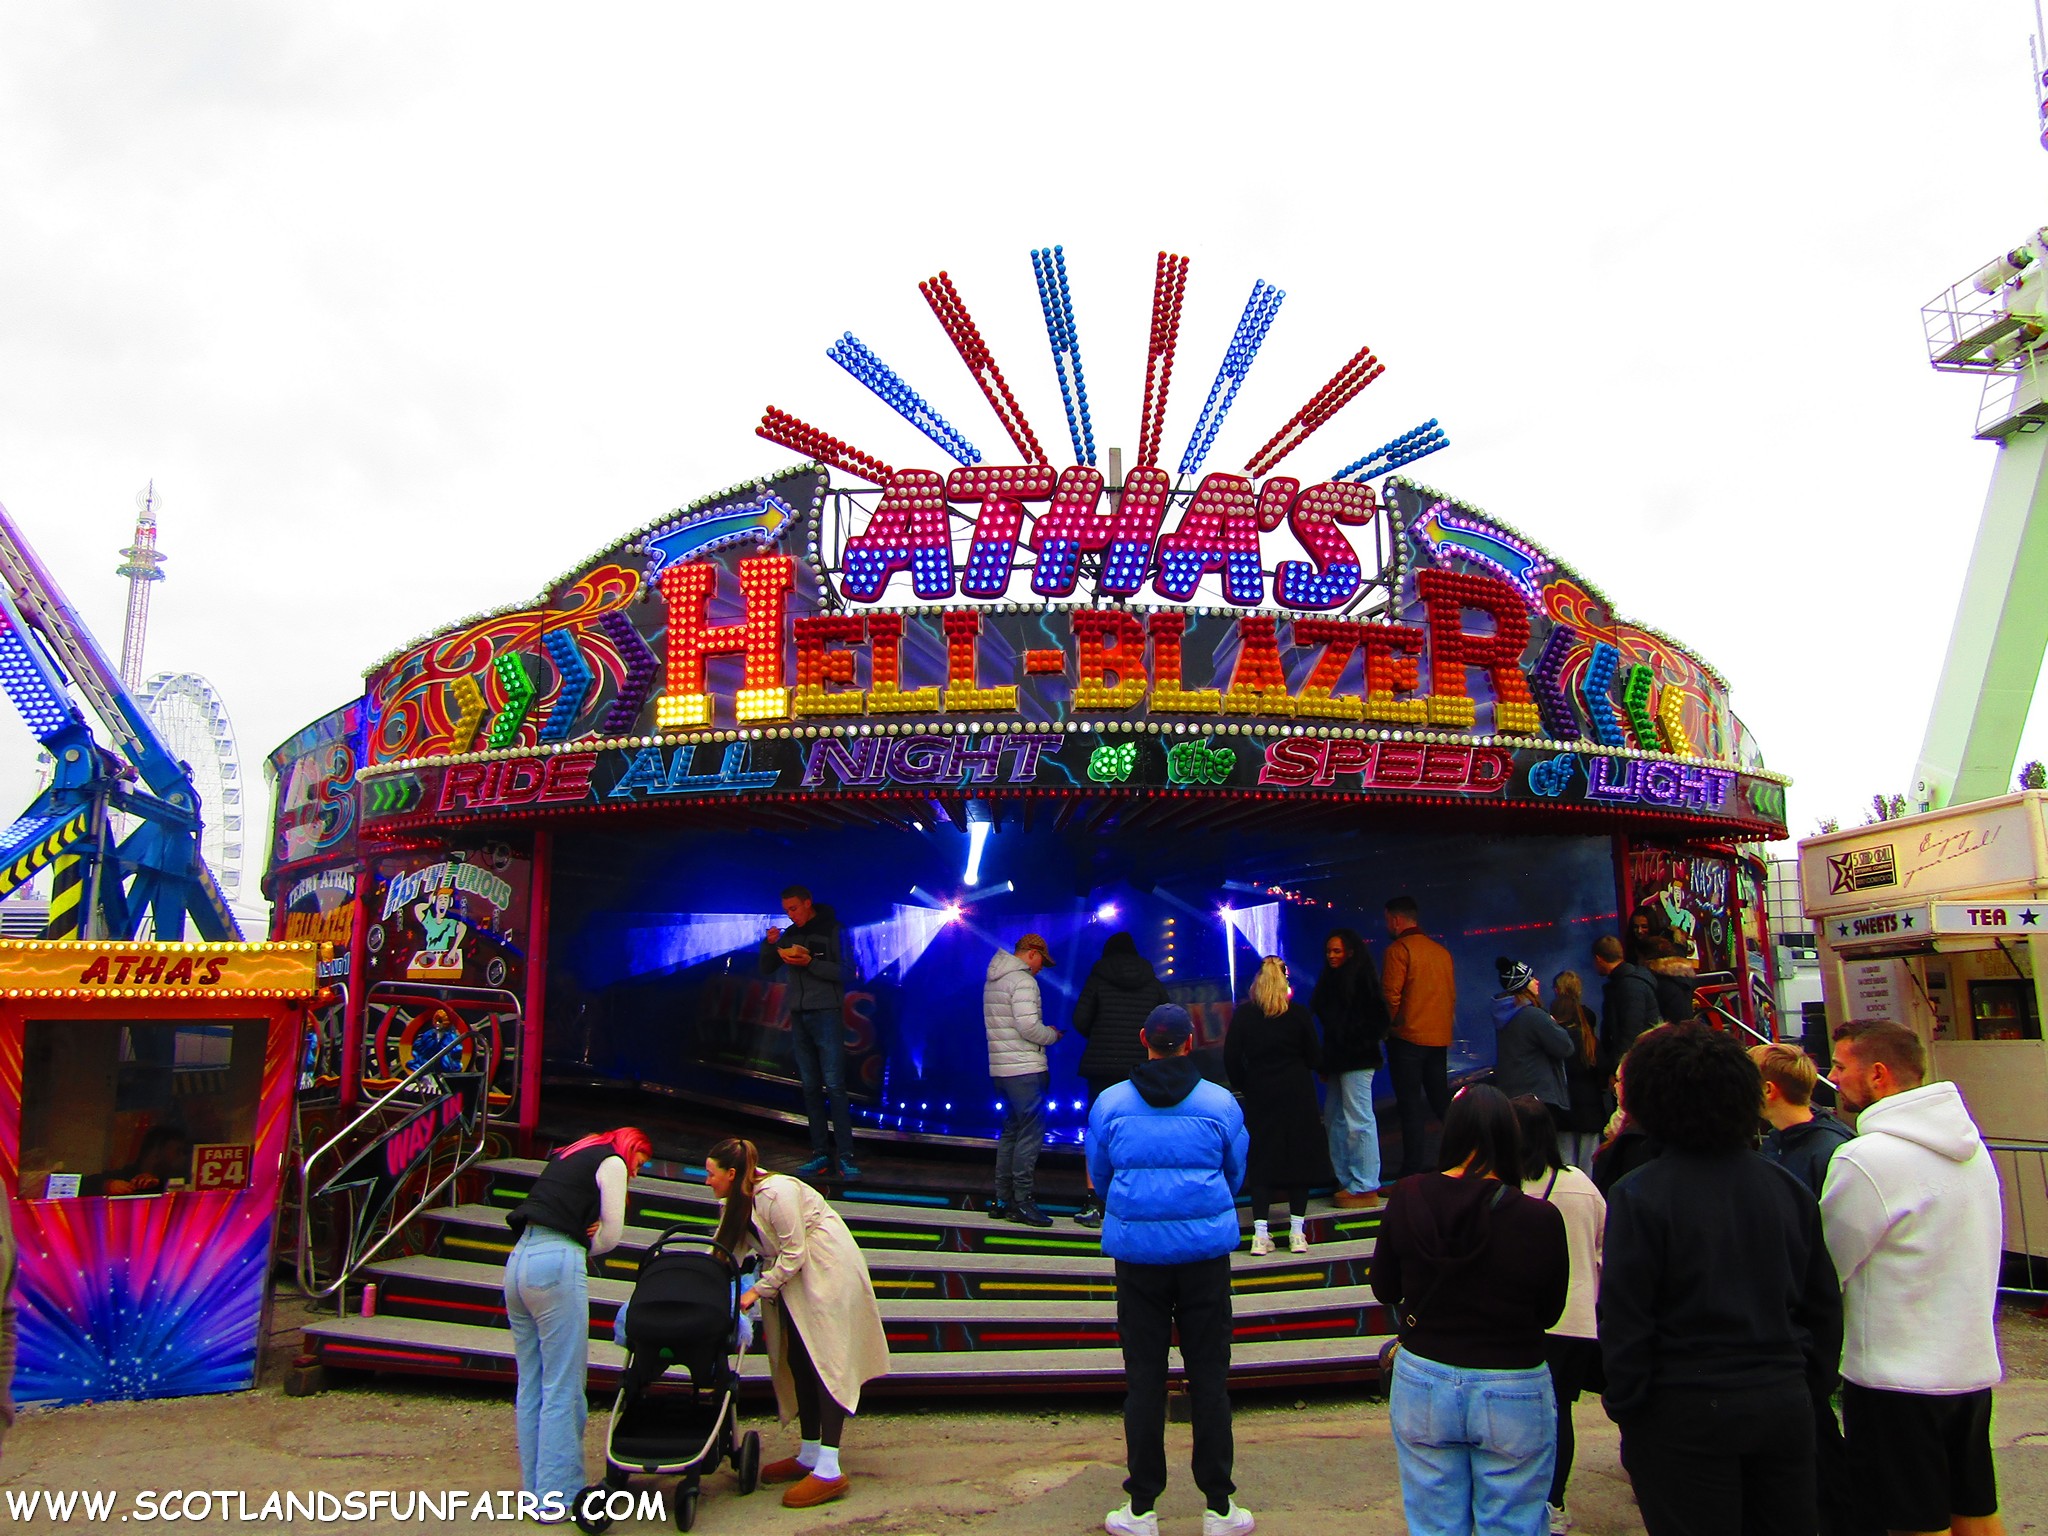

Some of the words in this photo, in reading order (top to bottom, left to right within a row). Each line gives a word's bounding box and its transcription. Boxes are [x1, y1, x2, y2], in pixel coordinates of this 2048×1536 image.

[841, 466, 1376, 607] ATHA'S
[437, 752, 598, 811] RIDE
[607, 741, 781, 799] ALL
[800, 734, 1066, 787] NIGHT
[1167, 739, 1238, 785] the
[1257, 735, 1516, 794] SPEED
[1584, 757, 1740, 813] LIGHT
[1918, 829, 1974, 858] Enjoy
[288, 872, 320, 909] TERRY
[382, 870, 426, 922] FAST
[1690, 857, 1727, 904] NASTY
[1853, 913, 1899, 936] SWEETS
[1966, 908, 2008, 926] TEA
[79, 955, 229, 985] ATHA'S
[386, 1109, 437, 1177] WAY
[441, 1092, 464, 1127] IN
[204, 1149, 244, 1160] FARE
[200, 1160, 246, 1186] £4
